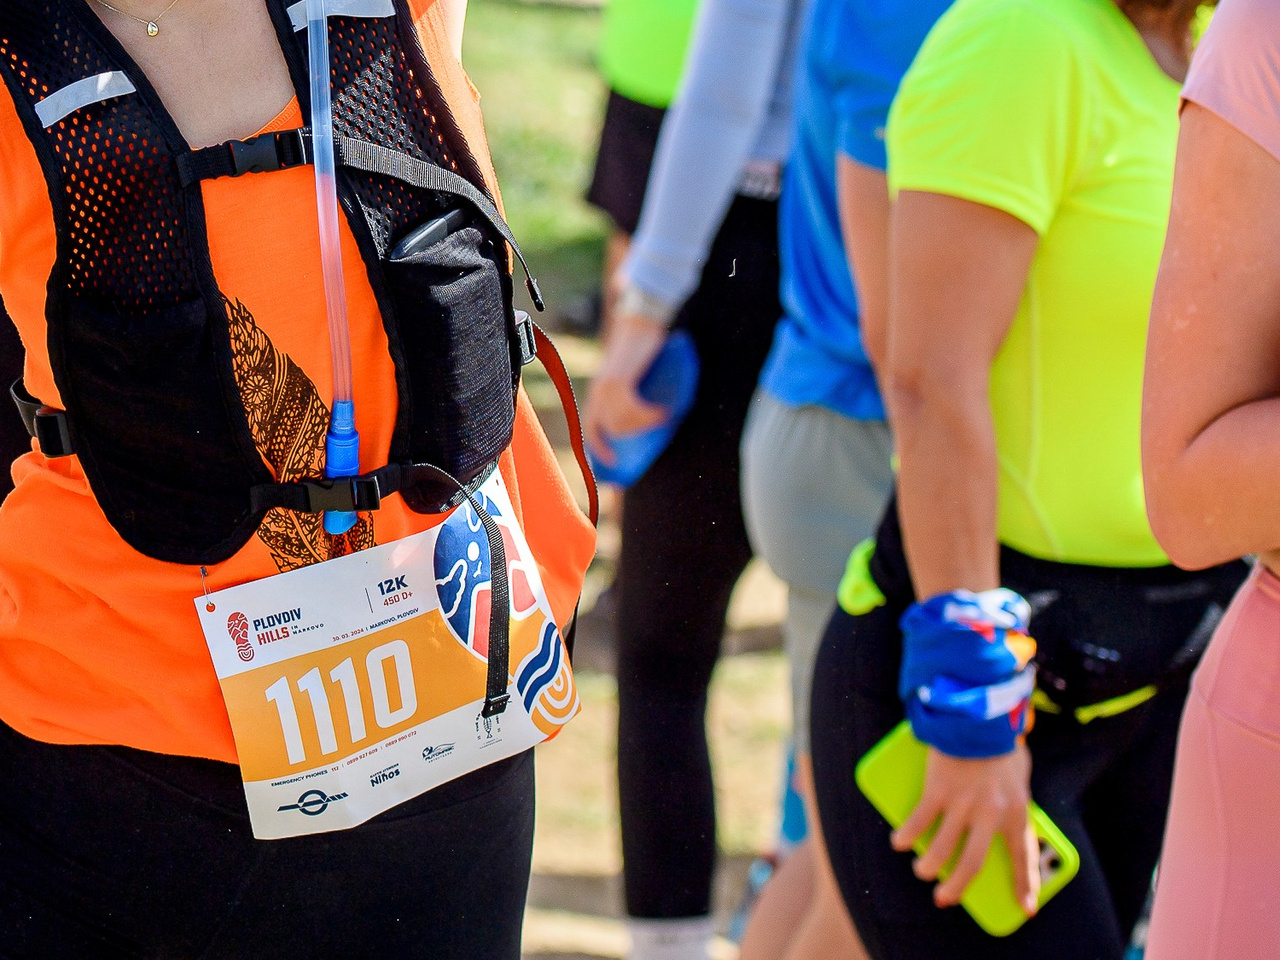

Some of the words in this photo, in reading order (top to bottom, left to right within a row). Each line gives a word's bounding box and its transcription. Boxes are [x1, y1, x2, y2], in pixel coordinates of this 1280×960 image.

[377, 574, 409, 596] 12K
[383, 594, 400, 607] 450
[252, 607, 302, 632] PLOVDIV
[397, 607, 419, 620] PLOVDIV
[257, 626, 290, 646] HILLS
[292, 623, 325, 635] MARKOVO
[264, 639, 418, 765] 1110
[271, 775, 305, 787] EMERGENCY
[305, 769, 328, 780] PHONES
